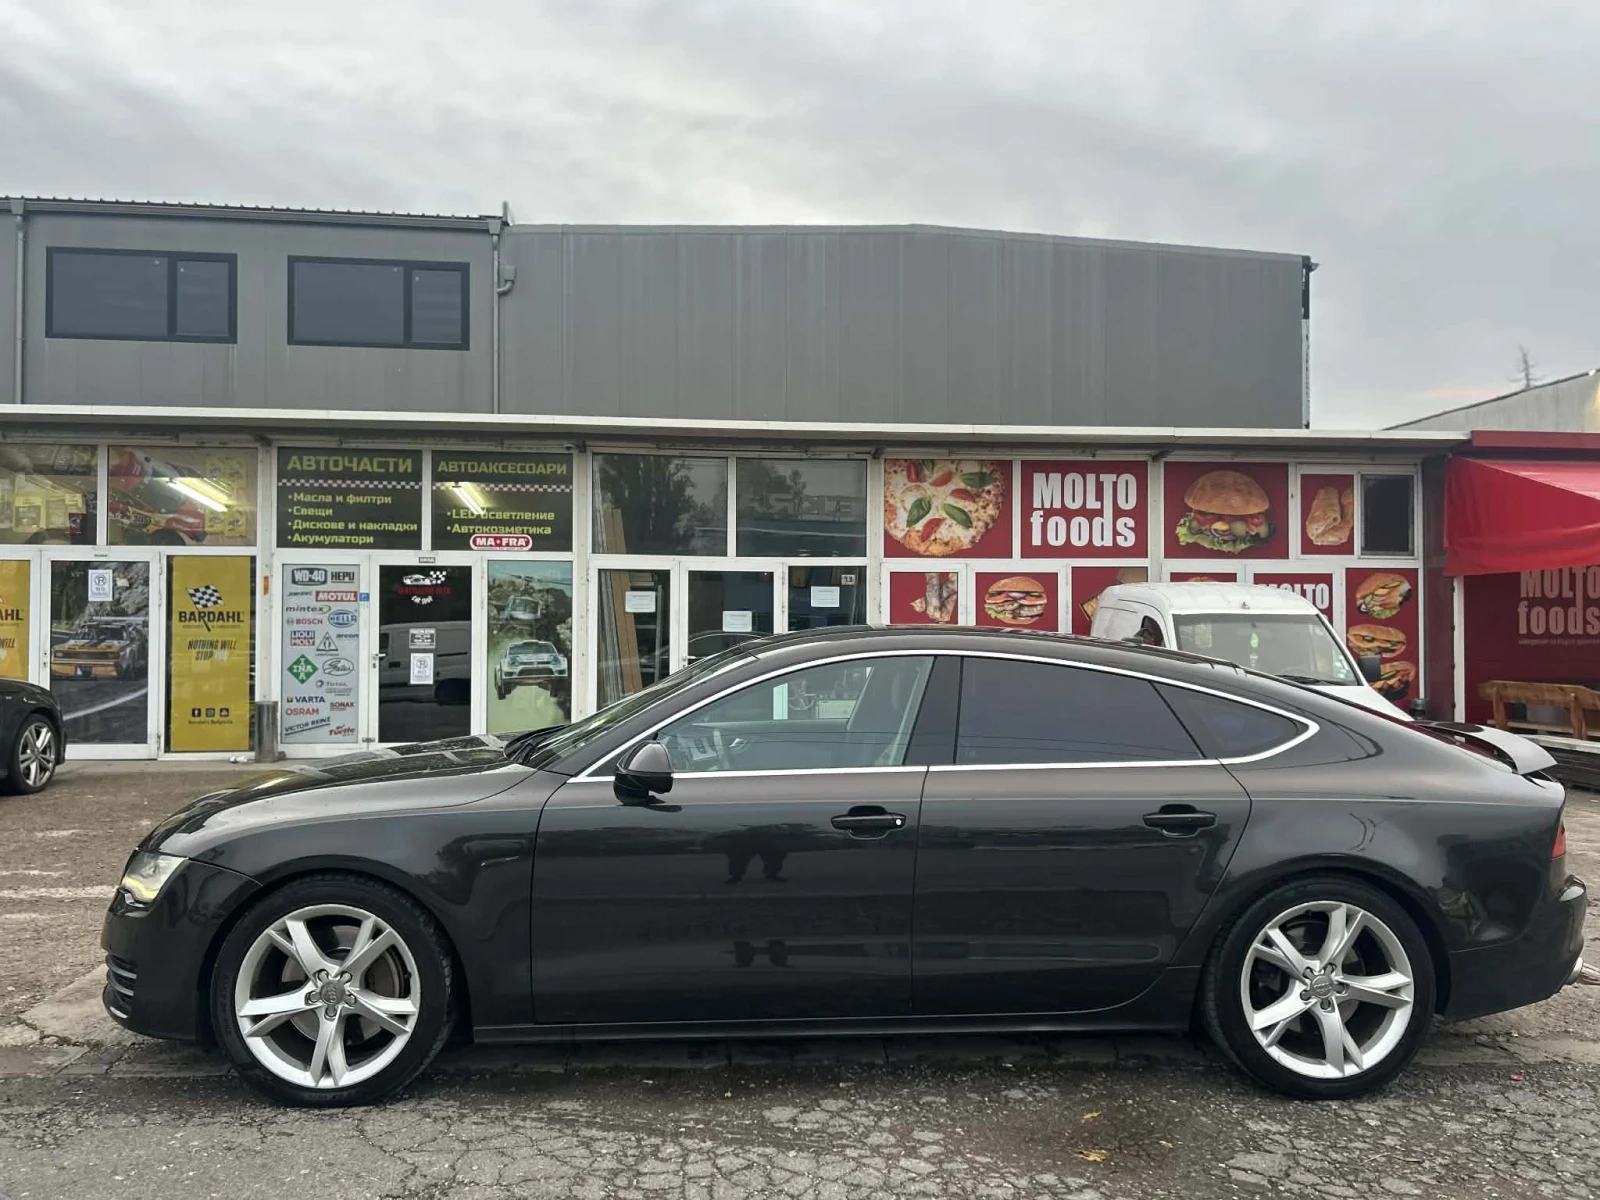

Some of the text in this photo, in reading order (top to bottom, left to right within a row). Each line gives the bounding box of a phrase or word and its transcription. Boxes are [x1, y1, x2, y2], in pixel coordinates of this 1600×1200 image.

[287, 456, 412, 473] АВТОЧАСТИ
[438, 462, 567, 475] АВТОАКСЕСОАРИ
[1033, 472, 1137, 511] MOLTO
[293, 493, 392, 506] Масла и филтри
[293, 506, 333, 517] Свещи
[292, 520, 418, 532] Дискове и накладки
[451, 523, 552, 535] Автокозметика
[1030, 511, 1136, 548] foods
[292, 533, 374, 545] Акумулатори
[331, 571, 355, 581] HEPU
[317, 592, 356, 601] MOTUL
[286, 605, 324, 613] mintex
[178, 610, 244, 623] BARDAHL
[330, 614, 357, 623] HELLA
[188, 639, 237, 650] NOTHING WILL
[286, 707, 320, 716] OSRAM
[285, 721, 310, 732] VICTOR
